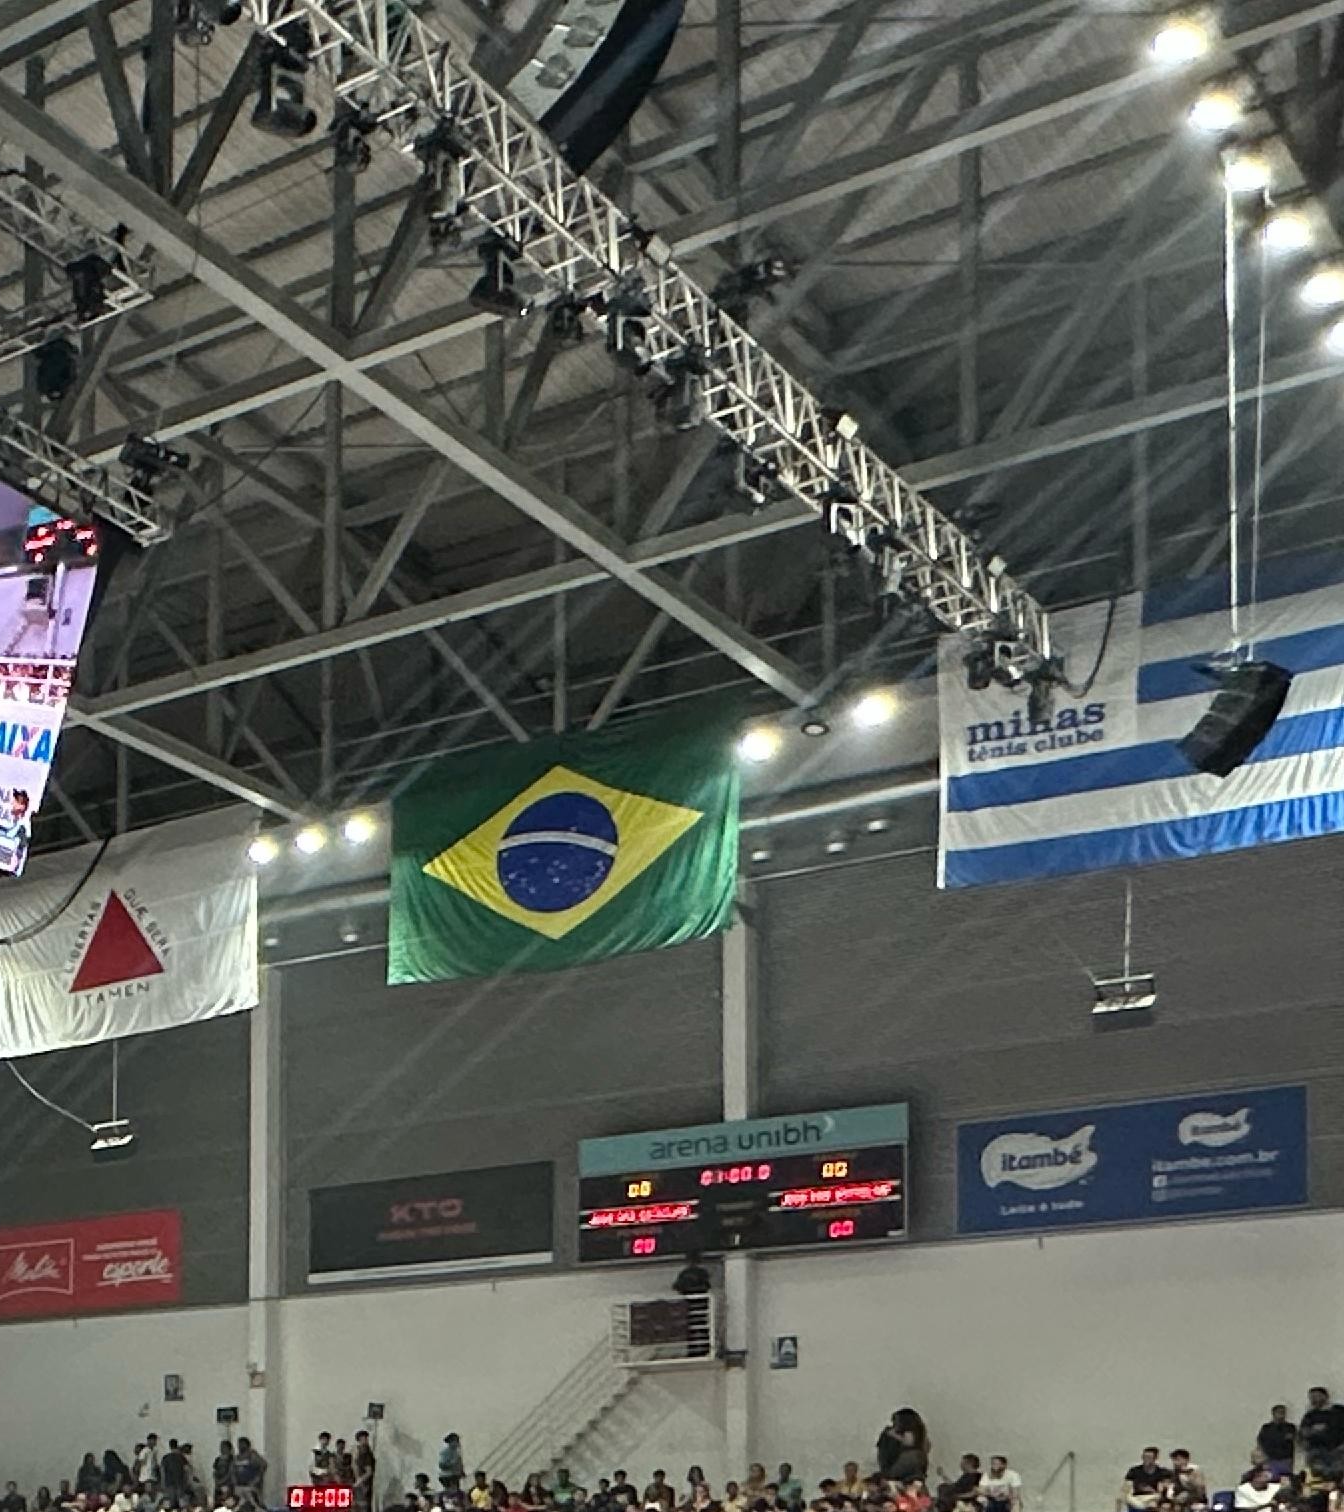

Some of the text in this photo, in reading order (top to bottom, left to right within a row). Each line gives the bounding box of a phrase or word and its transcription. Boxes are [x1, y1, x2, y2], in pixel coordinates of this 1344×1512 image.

[1033, 728, 1104, 755] clube
[85, 981, 151, 1004] TAMEN
[649, 1121, 823, 1161] arena unibh
[1001, 1143, 1082, 1172] itambé
[389, 1198, 464, 1225] KTO
[290, 1488, 350, 1508] 01:00
